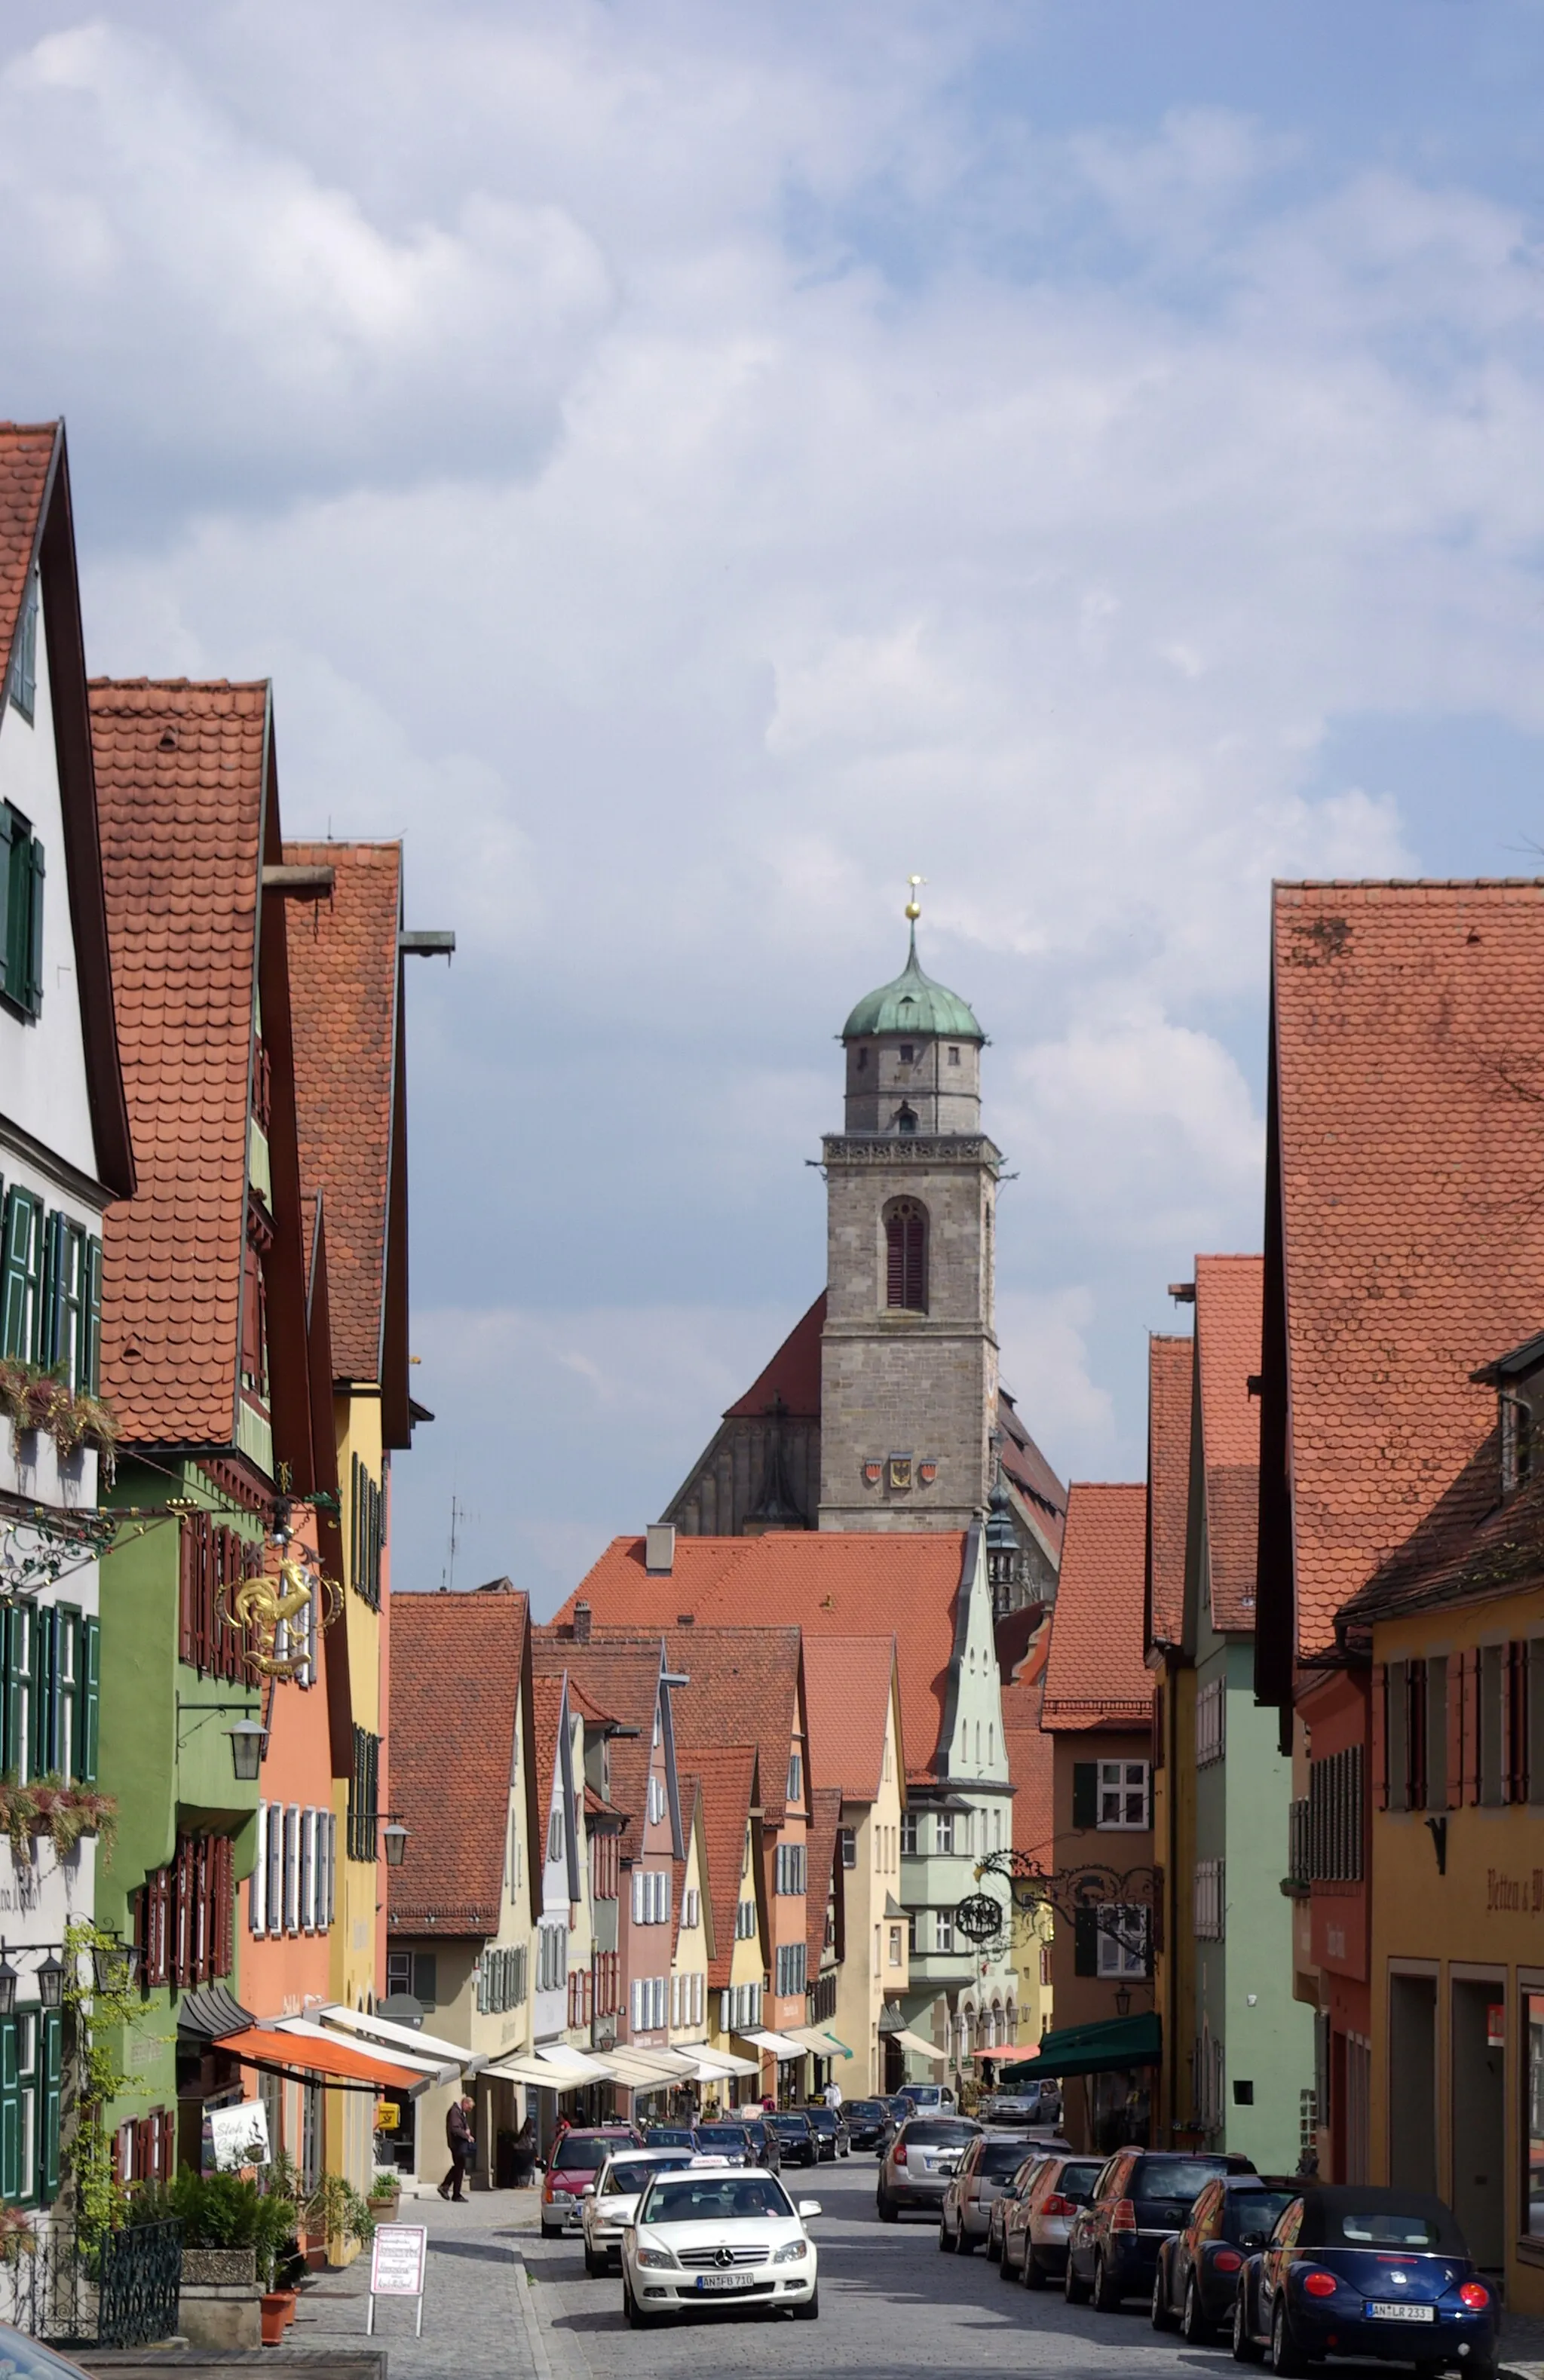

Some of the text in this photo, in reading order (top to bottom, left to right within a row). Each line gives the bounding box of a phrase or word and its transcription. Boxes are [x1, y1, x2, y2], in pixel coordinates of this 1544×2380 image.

[703, 2277, 715, 2286] AN
[735, 2275, 752, 2285] 710
[1374, 2305, 1386, 2315] AN
[1392, 2306, 1405, 2317] LR
